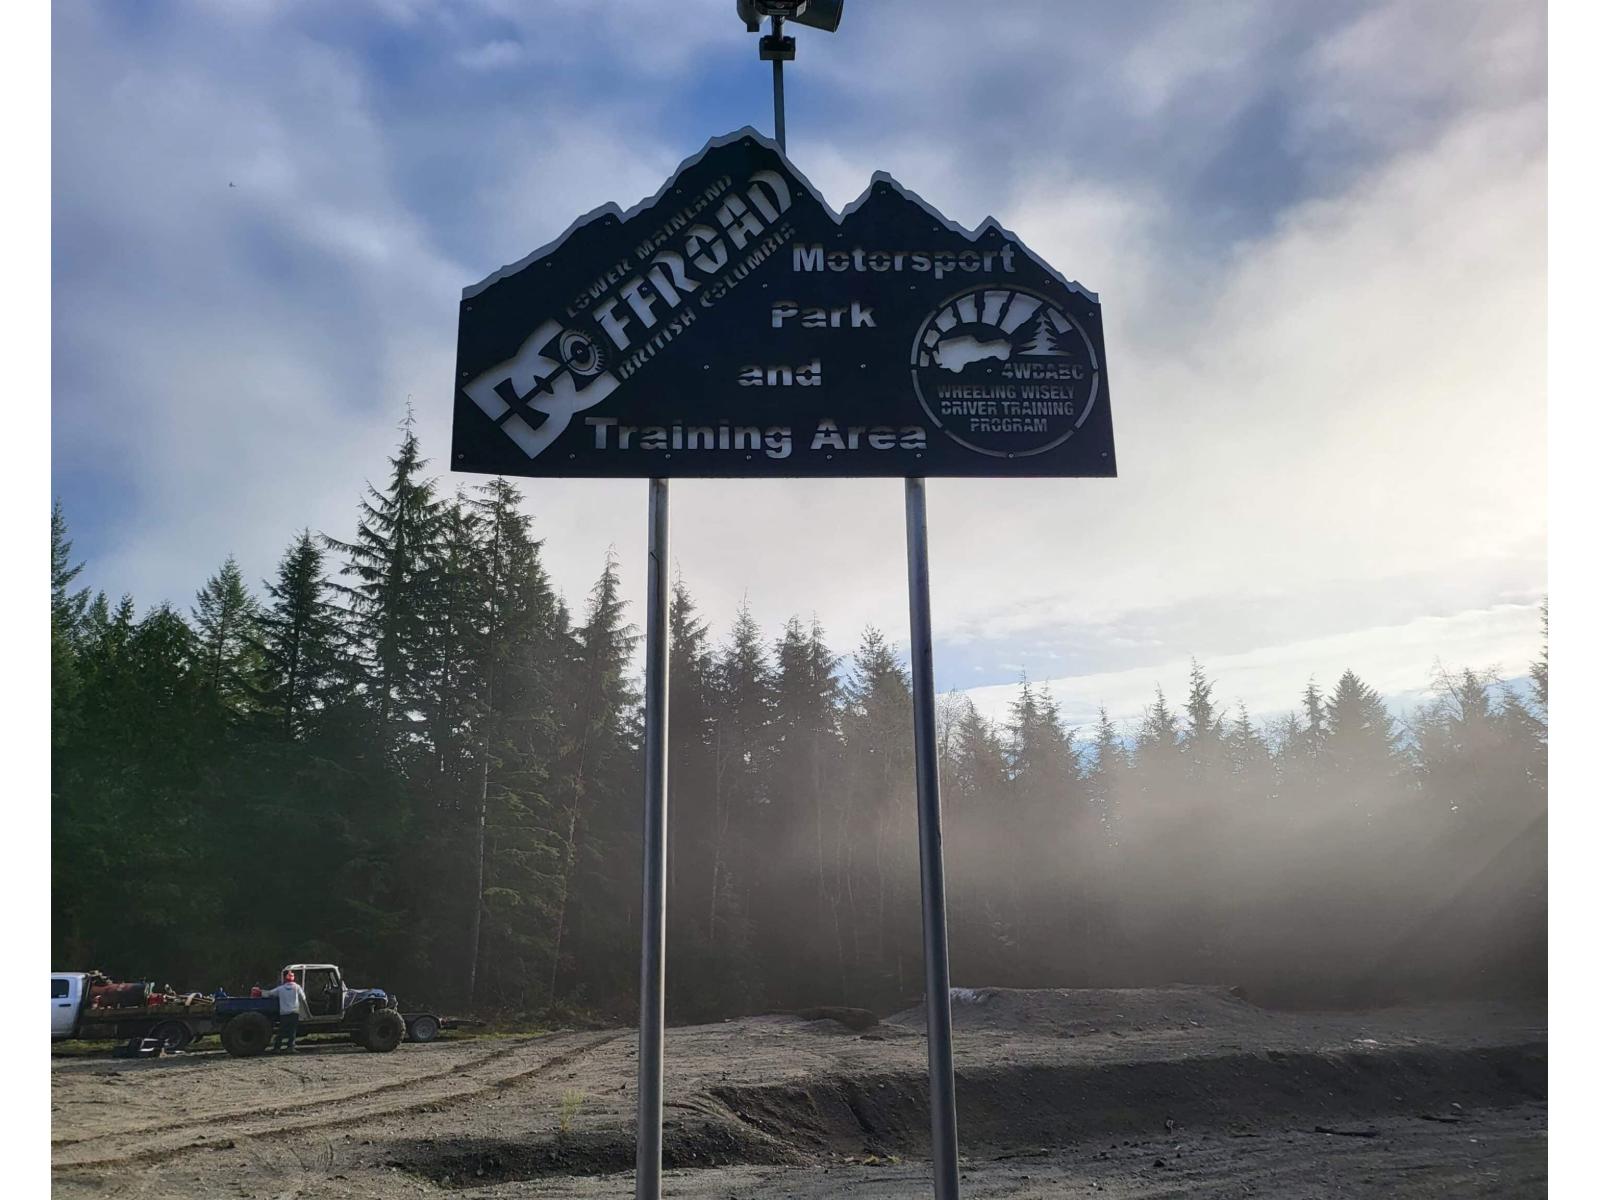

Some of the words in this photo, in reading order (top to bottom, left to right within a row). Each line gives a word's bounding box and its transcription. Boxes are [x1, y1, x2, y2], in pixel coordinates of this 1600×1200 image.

[566, 259, 634, 318] LOWER
[634, 175, 734, 261] MAINLAND
[792, 243, 1017, 279] Motorsport
[618, 307, 698, 380] BRITISH
[699, 221, 797, 309] COLUMBIA
[771, 299, 877, 328] Park
[737, 358, 822, 386] and
[936, 384, 1017, 399] WHEELING
[1020, 384, 1076, 400] WISELY
[941, 400, 998, 416] DRIVER
[1001, 400, 1075, 416] TRAINING
[584, 416, 793, 459] Training
[809, 417, 928, 450] Area
[969, 417, 1048, 433] PROGRAM
